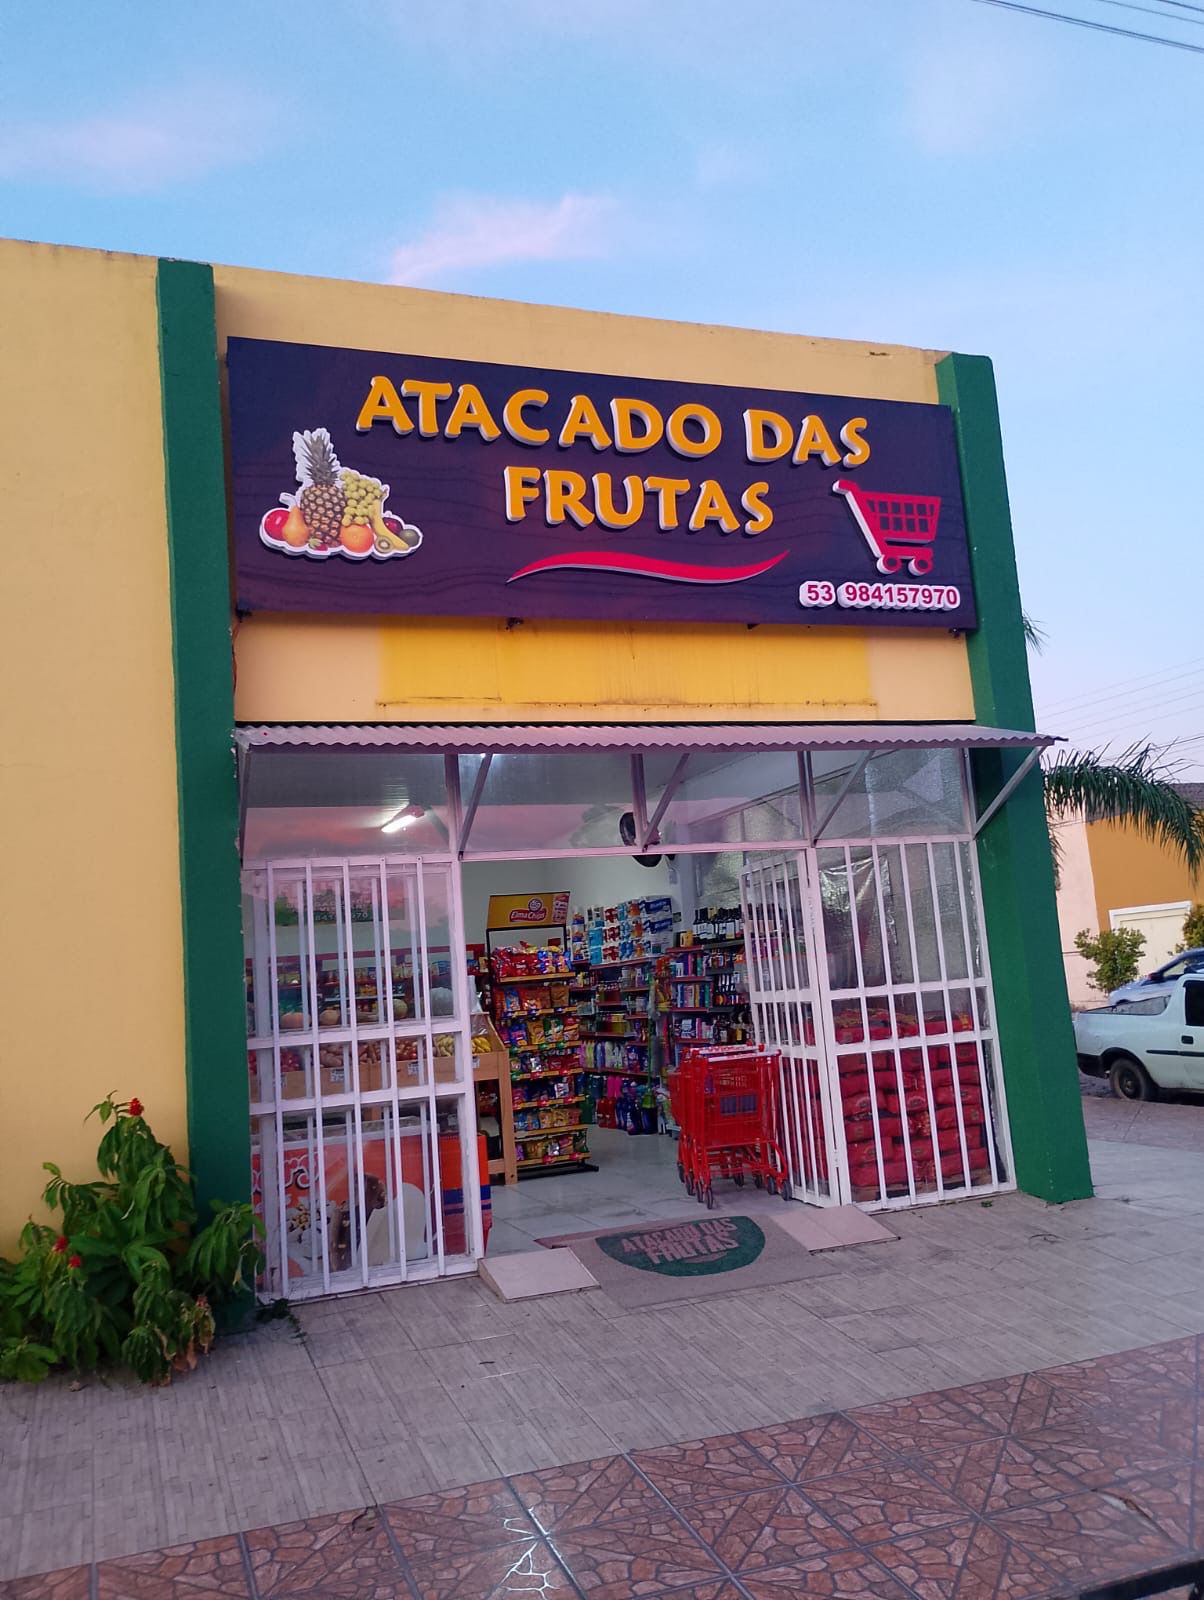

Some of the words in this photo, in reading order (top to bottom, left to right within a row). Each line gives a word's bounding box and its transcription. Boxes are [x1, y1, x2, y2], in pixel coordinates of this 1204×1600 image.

[356, 376, 722, 458] ATACADO
[743, 409, 870, 468] DAS
[504, 466, 773, 534] FRUTAS
[804, 583, 834, 604] 53
[842, 583, 959, 607] 984157970
[622, 1223, 702, 1252] ATACADO
[699, 1218, 738, 1236] DAS
[648, 1234, 739, 1264] FRUTAS
